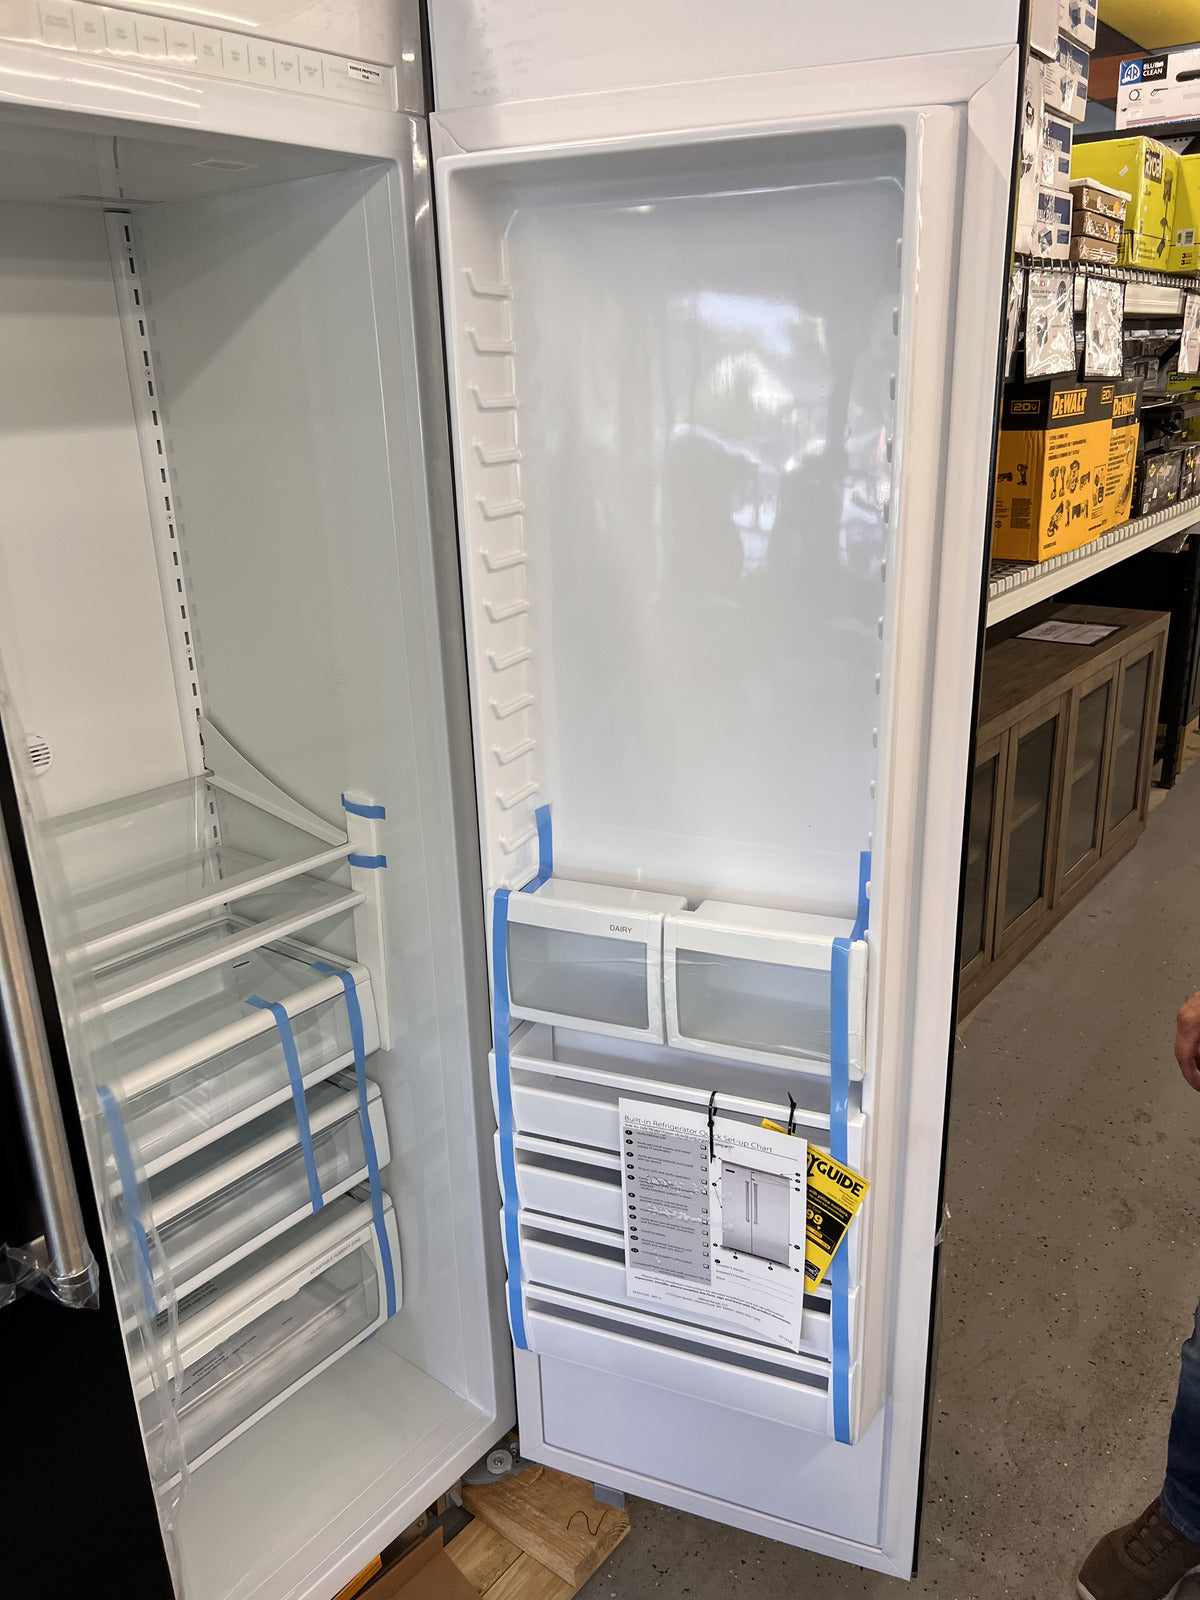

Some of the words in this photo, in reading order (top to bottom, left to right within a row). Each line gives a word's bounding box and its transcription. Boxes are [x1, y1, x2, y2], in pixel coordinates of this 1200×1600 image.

[1142, 68, 1163, 77] CLEAN
[609, 924, 633, 933] DAIRY
[652, 1120, 697, 1135] Refrigerator
[723, 1135, 750, 1148] Set-up
[750, 1142, 773, 1153] Chart
